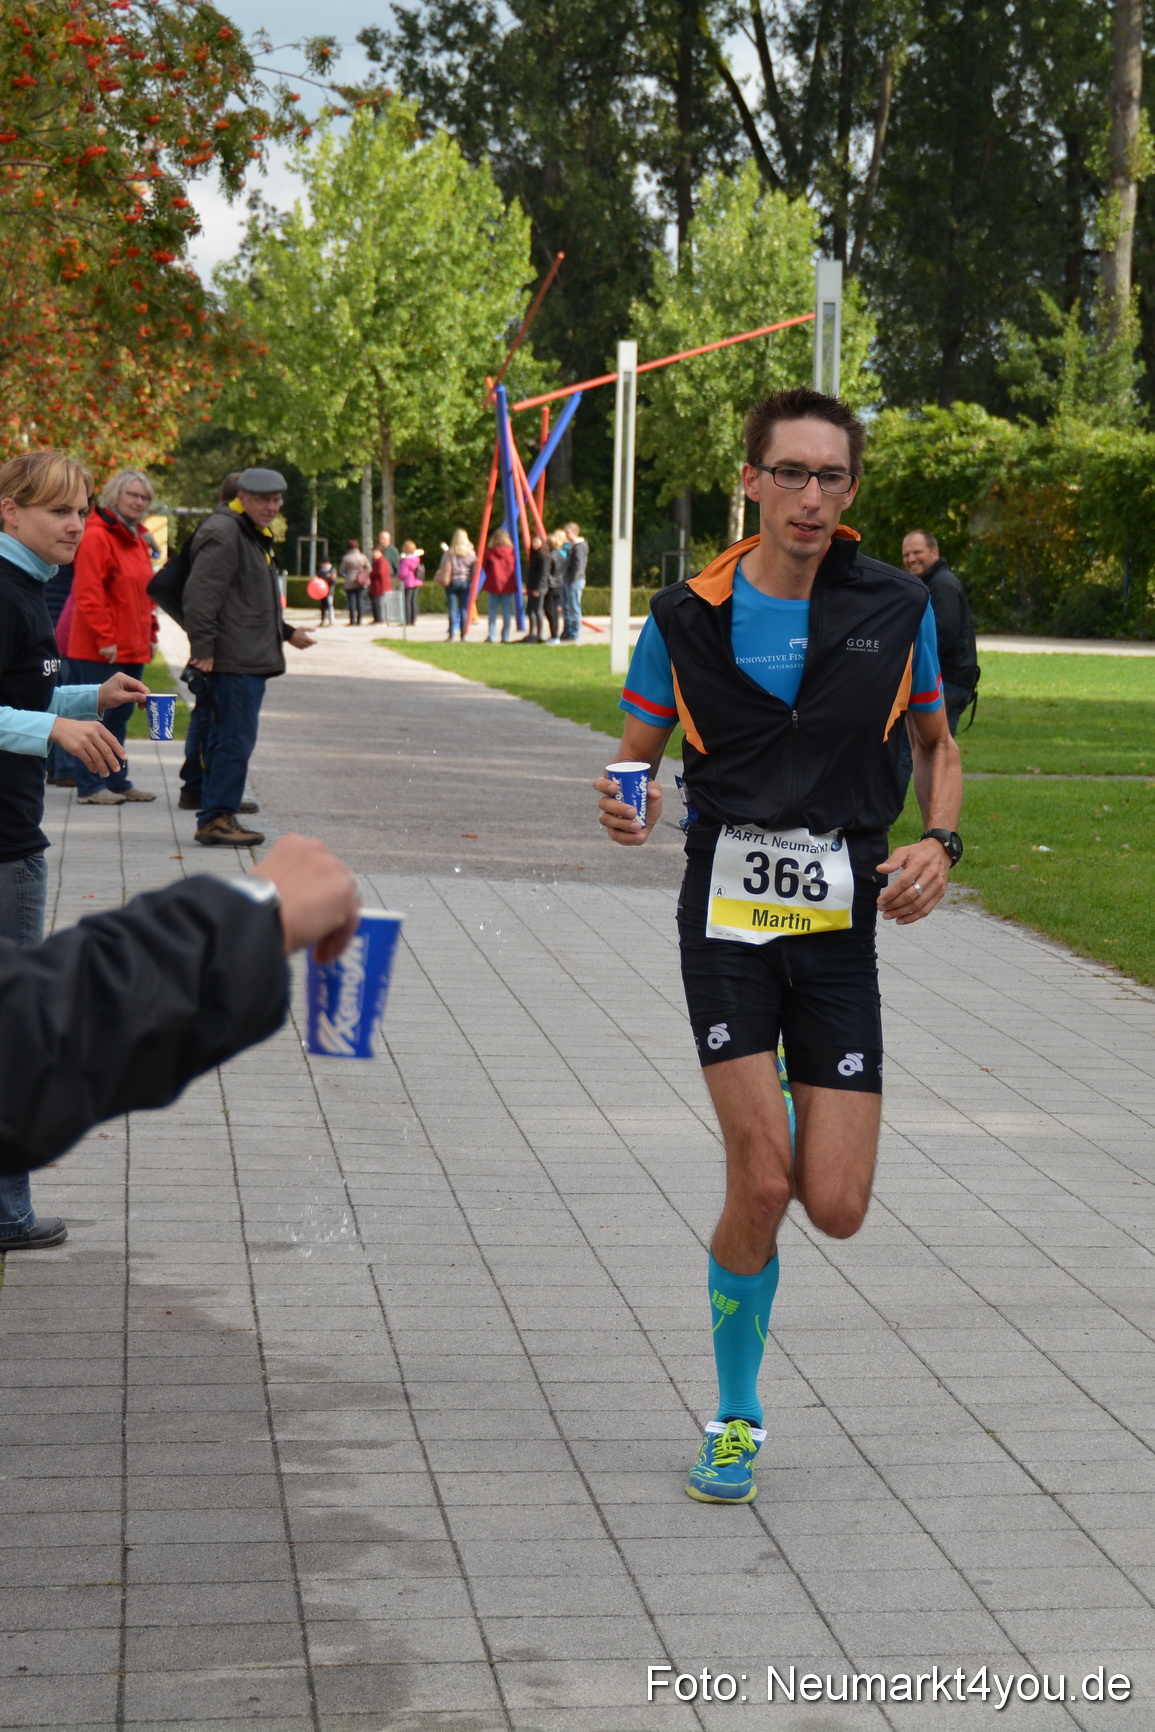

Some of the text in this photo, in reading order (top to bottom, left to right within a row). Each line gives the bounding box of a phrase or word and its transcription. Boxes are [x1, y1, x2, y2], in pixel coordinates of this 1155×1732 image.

[846, 638, 880, 649] GORE
[724, 827, 829, 854] PARTL Neumarkt
[743, 851, 829, 902] 363
[716, 887, 723, 896] A
[752, 908, 812, 932] Martin
